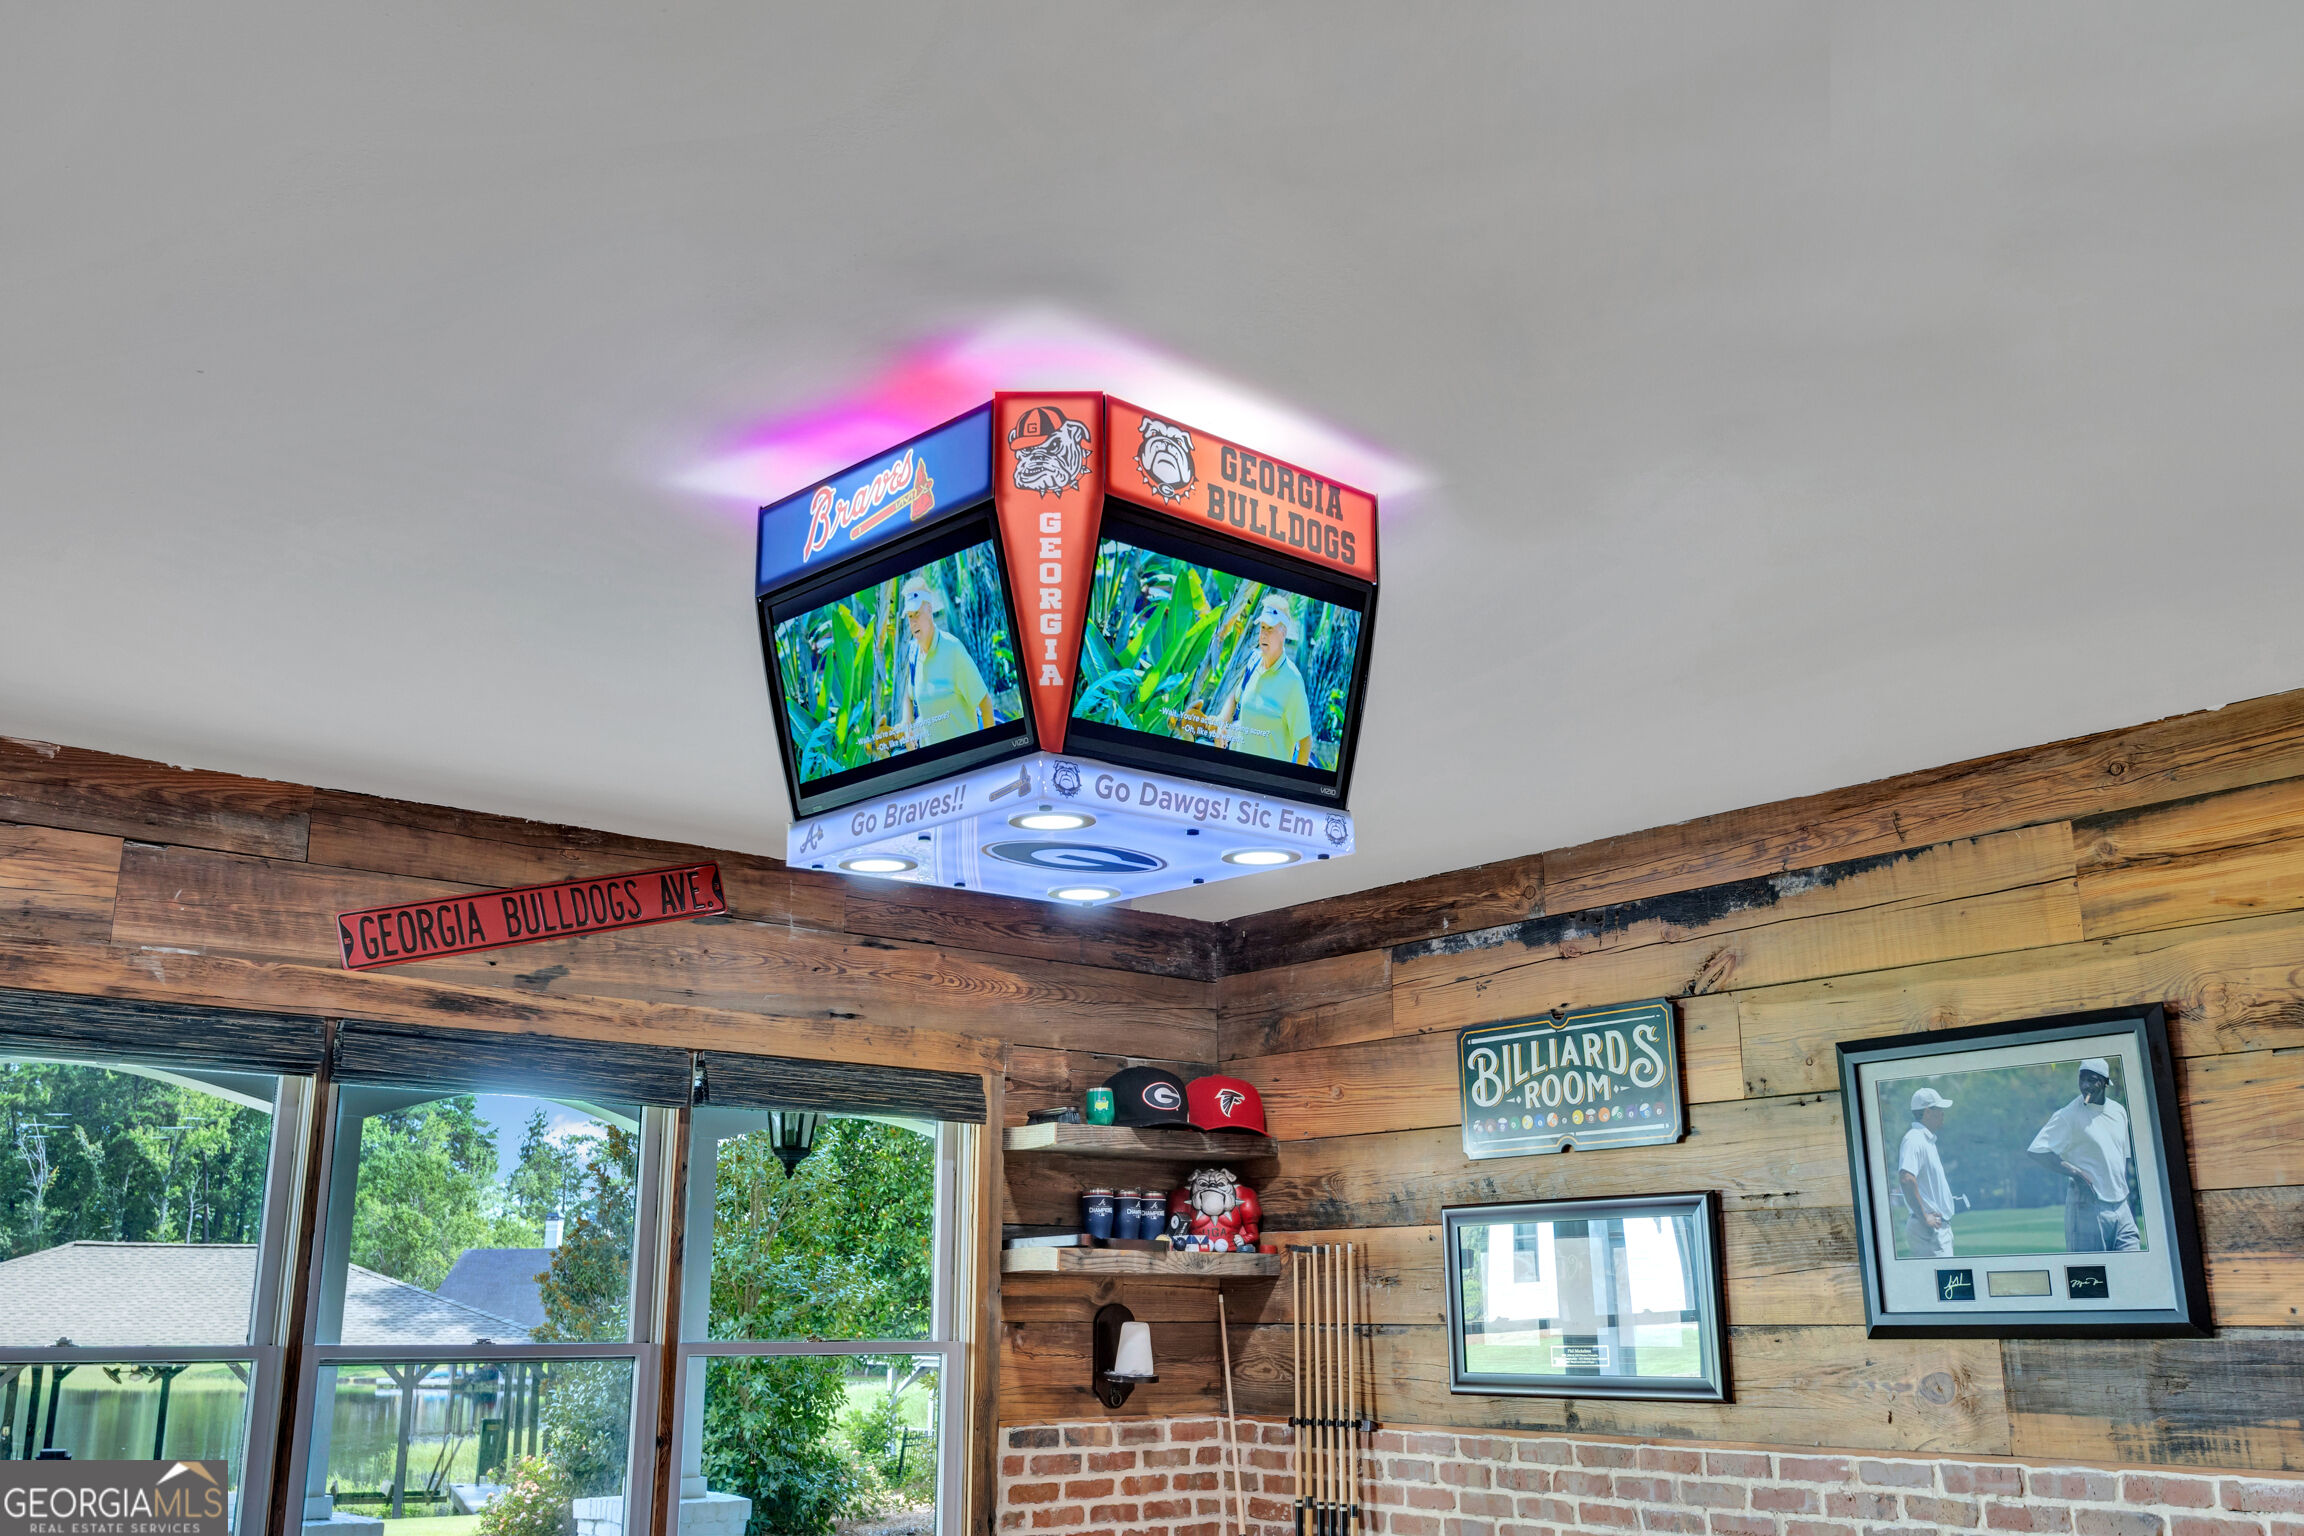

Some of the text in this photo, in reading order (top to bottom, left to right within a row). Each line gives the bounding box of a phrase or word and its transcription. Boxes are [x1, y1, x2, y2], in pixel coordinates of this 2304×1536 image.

[1027, 423, 1037, 433] G
[803, 448, 914, 563] Braves
[1220, 445, 1344, 521] GEORGIA
[1206, 482, 1356, 566] BULLDOGS
[1039, 512, 1064, 686] GEORGIA
[1011, 737, 1029, 748] VIZIO
[1196, 726, 1208, 737] like
[851, 784, 967, 837] Go Braves!!
[1094, 773, 1314, 837] Go Dawgs! Sic Em
[1320, 786, 1337, 796] VIZIO
[988, 841, 1161, 873] G
[359, 871, 715, 960] GEORGIA BULLDOGS AVE.
[1467, 1024, 1667, 1108] BILLIARDS
[1523, 1071, 1612, 1110] ROOM
[1142, 1081, 1181, 1110] G
